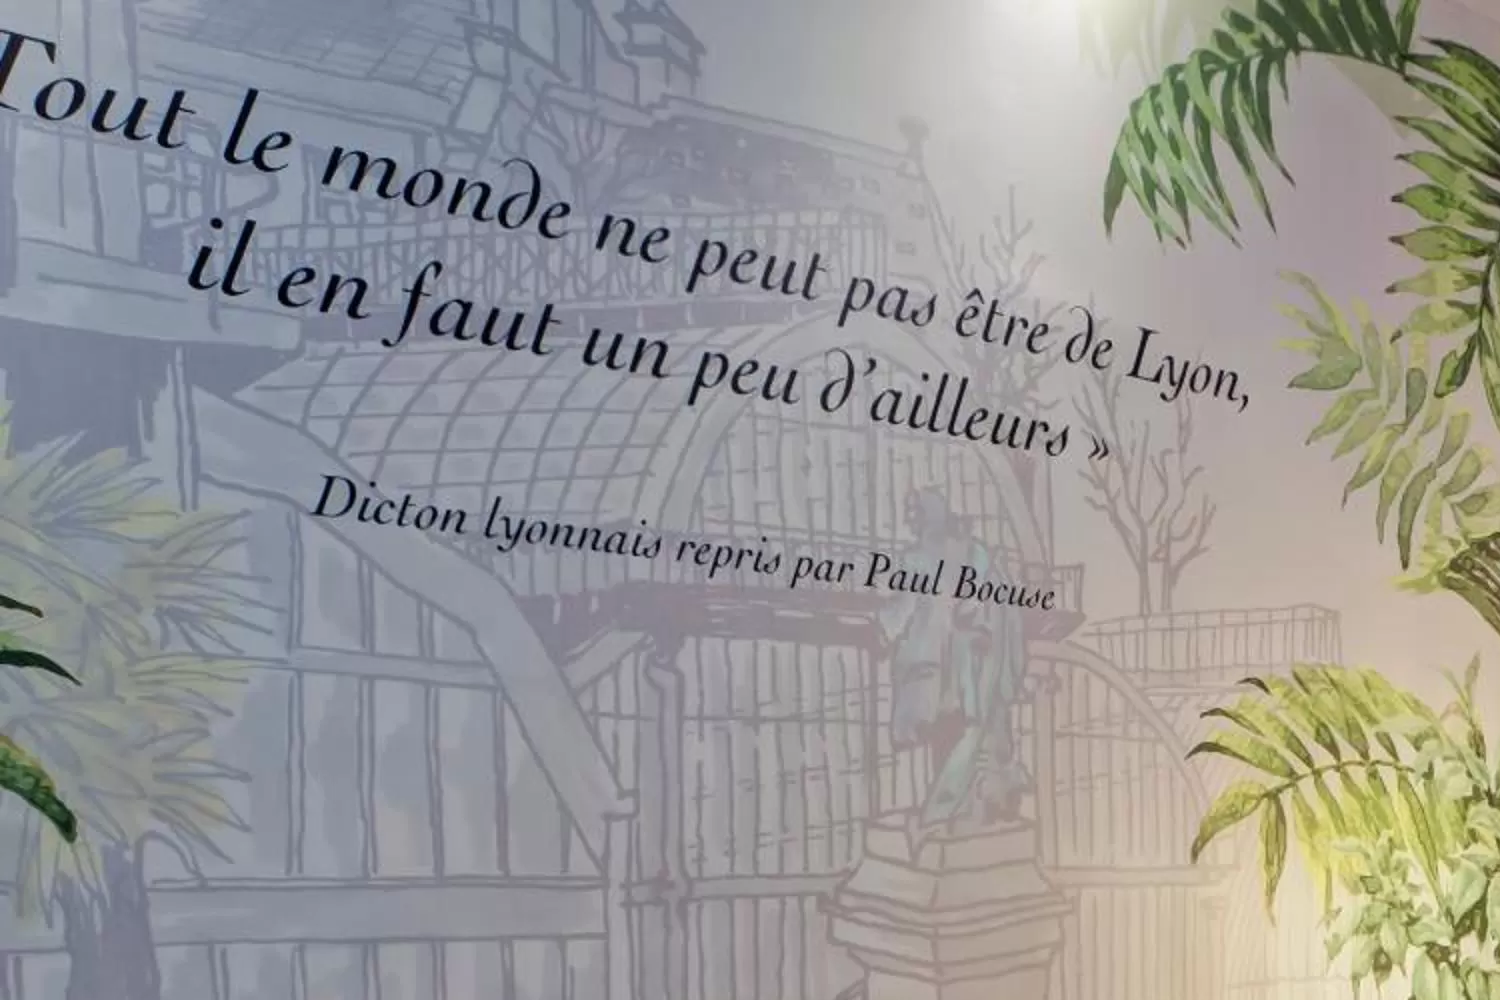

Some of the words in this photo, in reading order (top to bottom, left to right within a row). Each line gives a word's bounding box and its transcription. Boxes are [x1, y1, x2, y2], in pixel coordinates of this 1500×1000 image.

[0, 29, 196, 149] Tout
[223, 88, 293, 173] le
[321, 146, 572, 240] monde
[595, 213, 671, 263] ne
[685, 238, 827, 301] peut
[838, 276, 937, 327] pas
[955, 288, 1051, 354] être
[1064, 304, 1114, 370] de
[1126, 326, 1251, 411] Lyon,
[186, 217, 257, 297] il
[277, 265, 371, 320] en
[381, 260, 562, 356] faut
[582, 327, 671, 379] un
[687, 350, 800, 405] peu
[310, 473, 467, 536] Dicton
[483, 495, 662, 553] lyonnais
[675, 536, 782, 579] repris
[790, 555, 855, 589] par
[864, 551, 945, 596] Paul
[954, 564, 1056, 611] Bocuse
